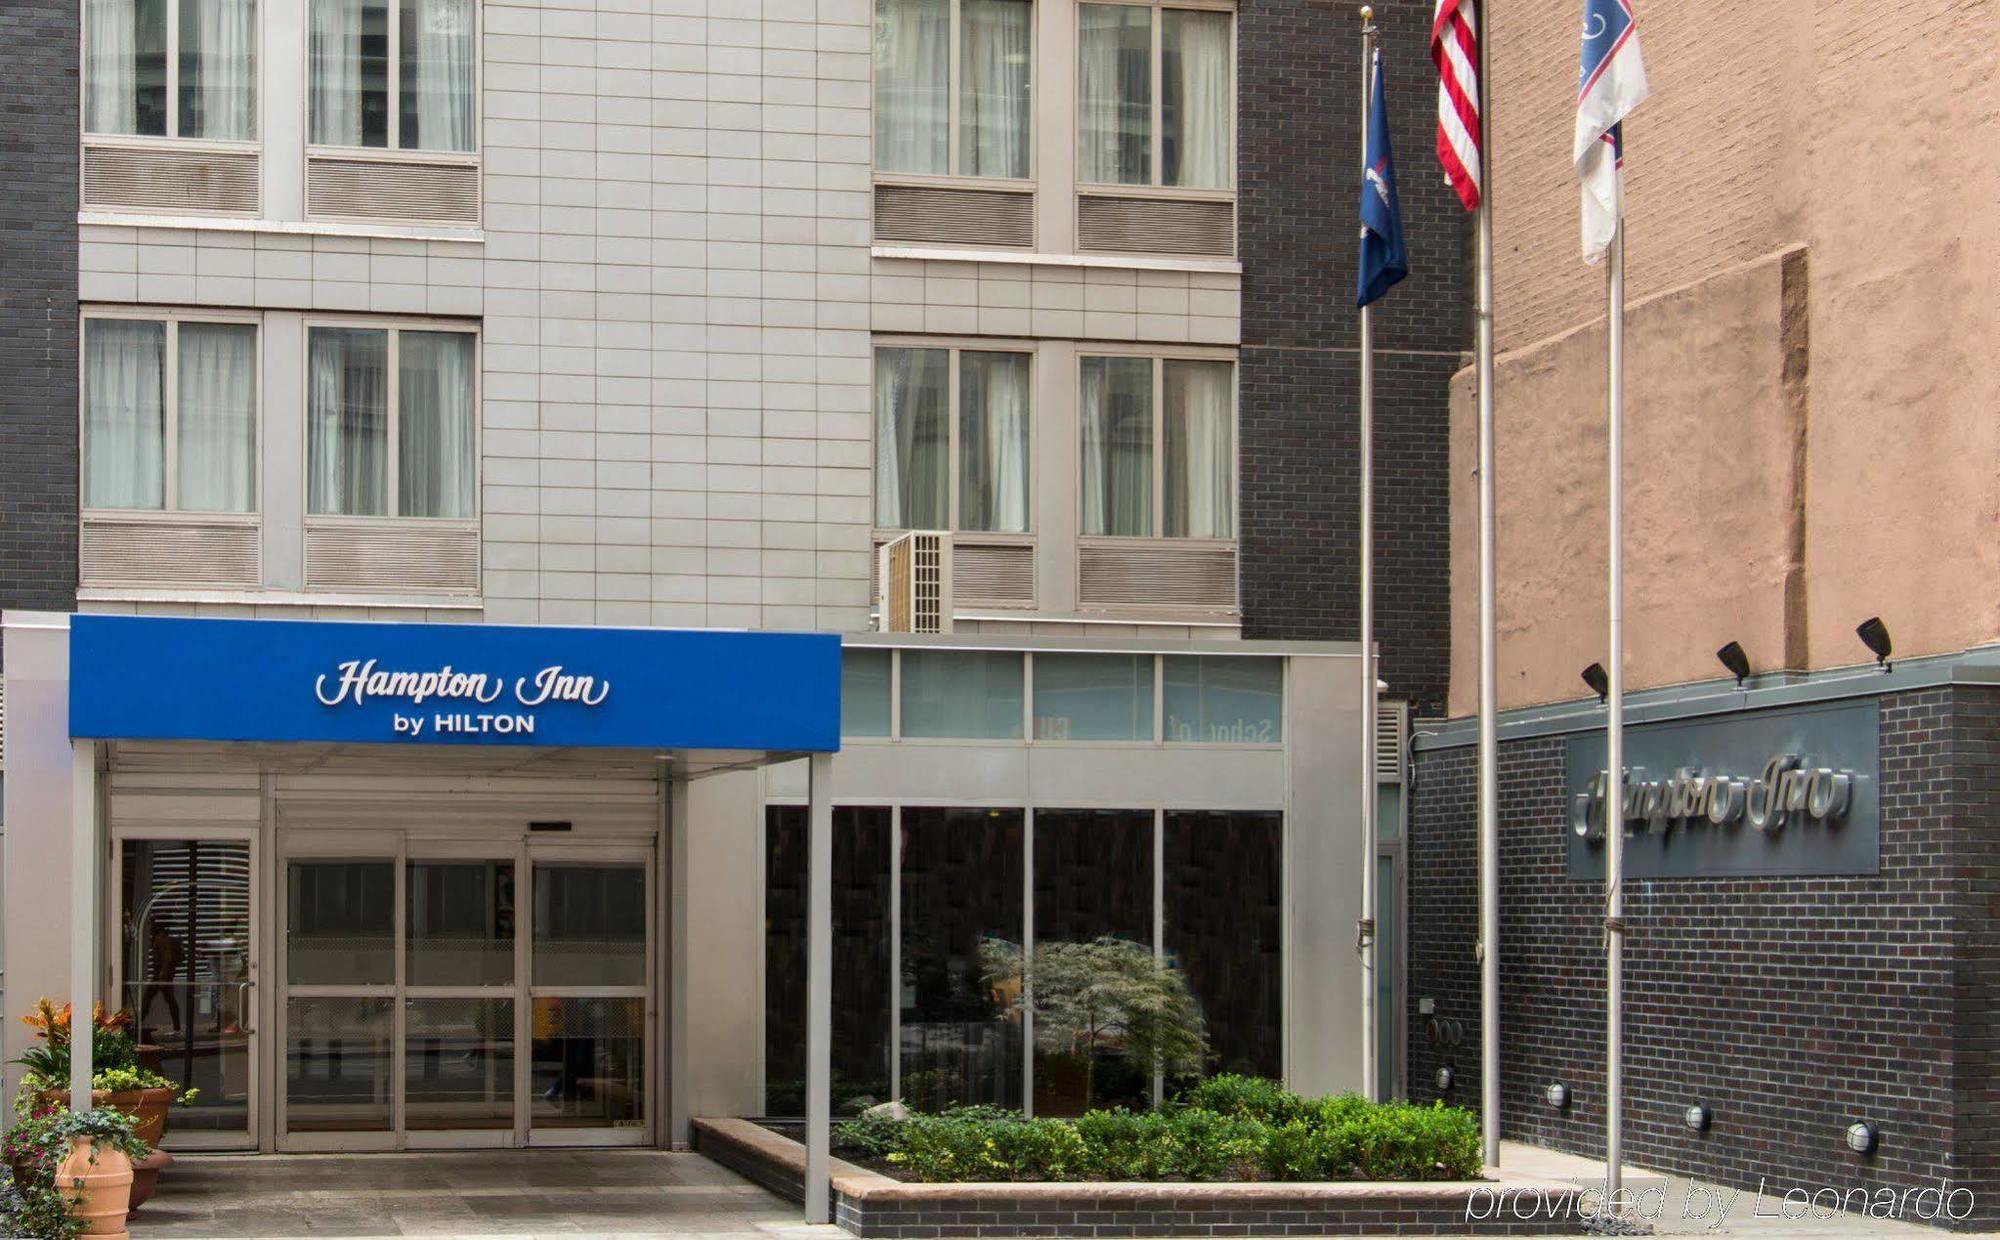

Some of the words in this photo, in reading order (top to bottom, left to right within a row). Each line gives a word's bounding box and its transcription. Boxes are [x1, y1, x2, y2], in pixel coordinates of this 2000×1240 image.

[315, 658, 503, 705] Hampton
[515, 665, 610, 705] Inn
[394, 713, 425, 736] by
[434, 714, 535, 733] HILTON
[1746, 752, 1852, 832] Inn
